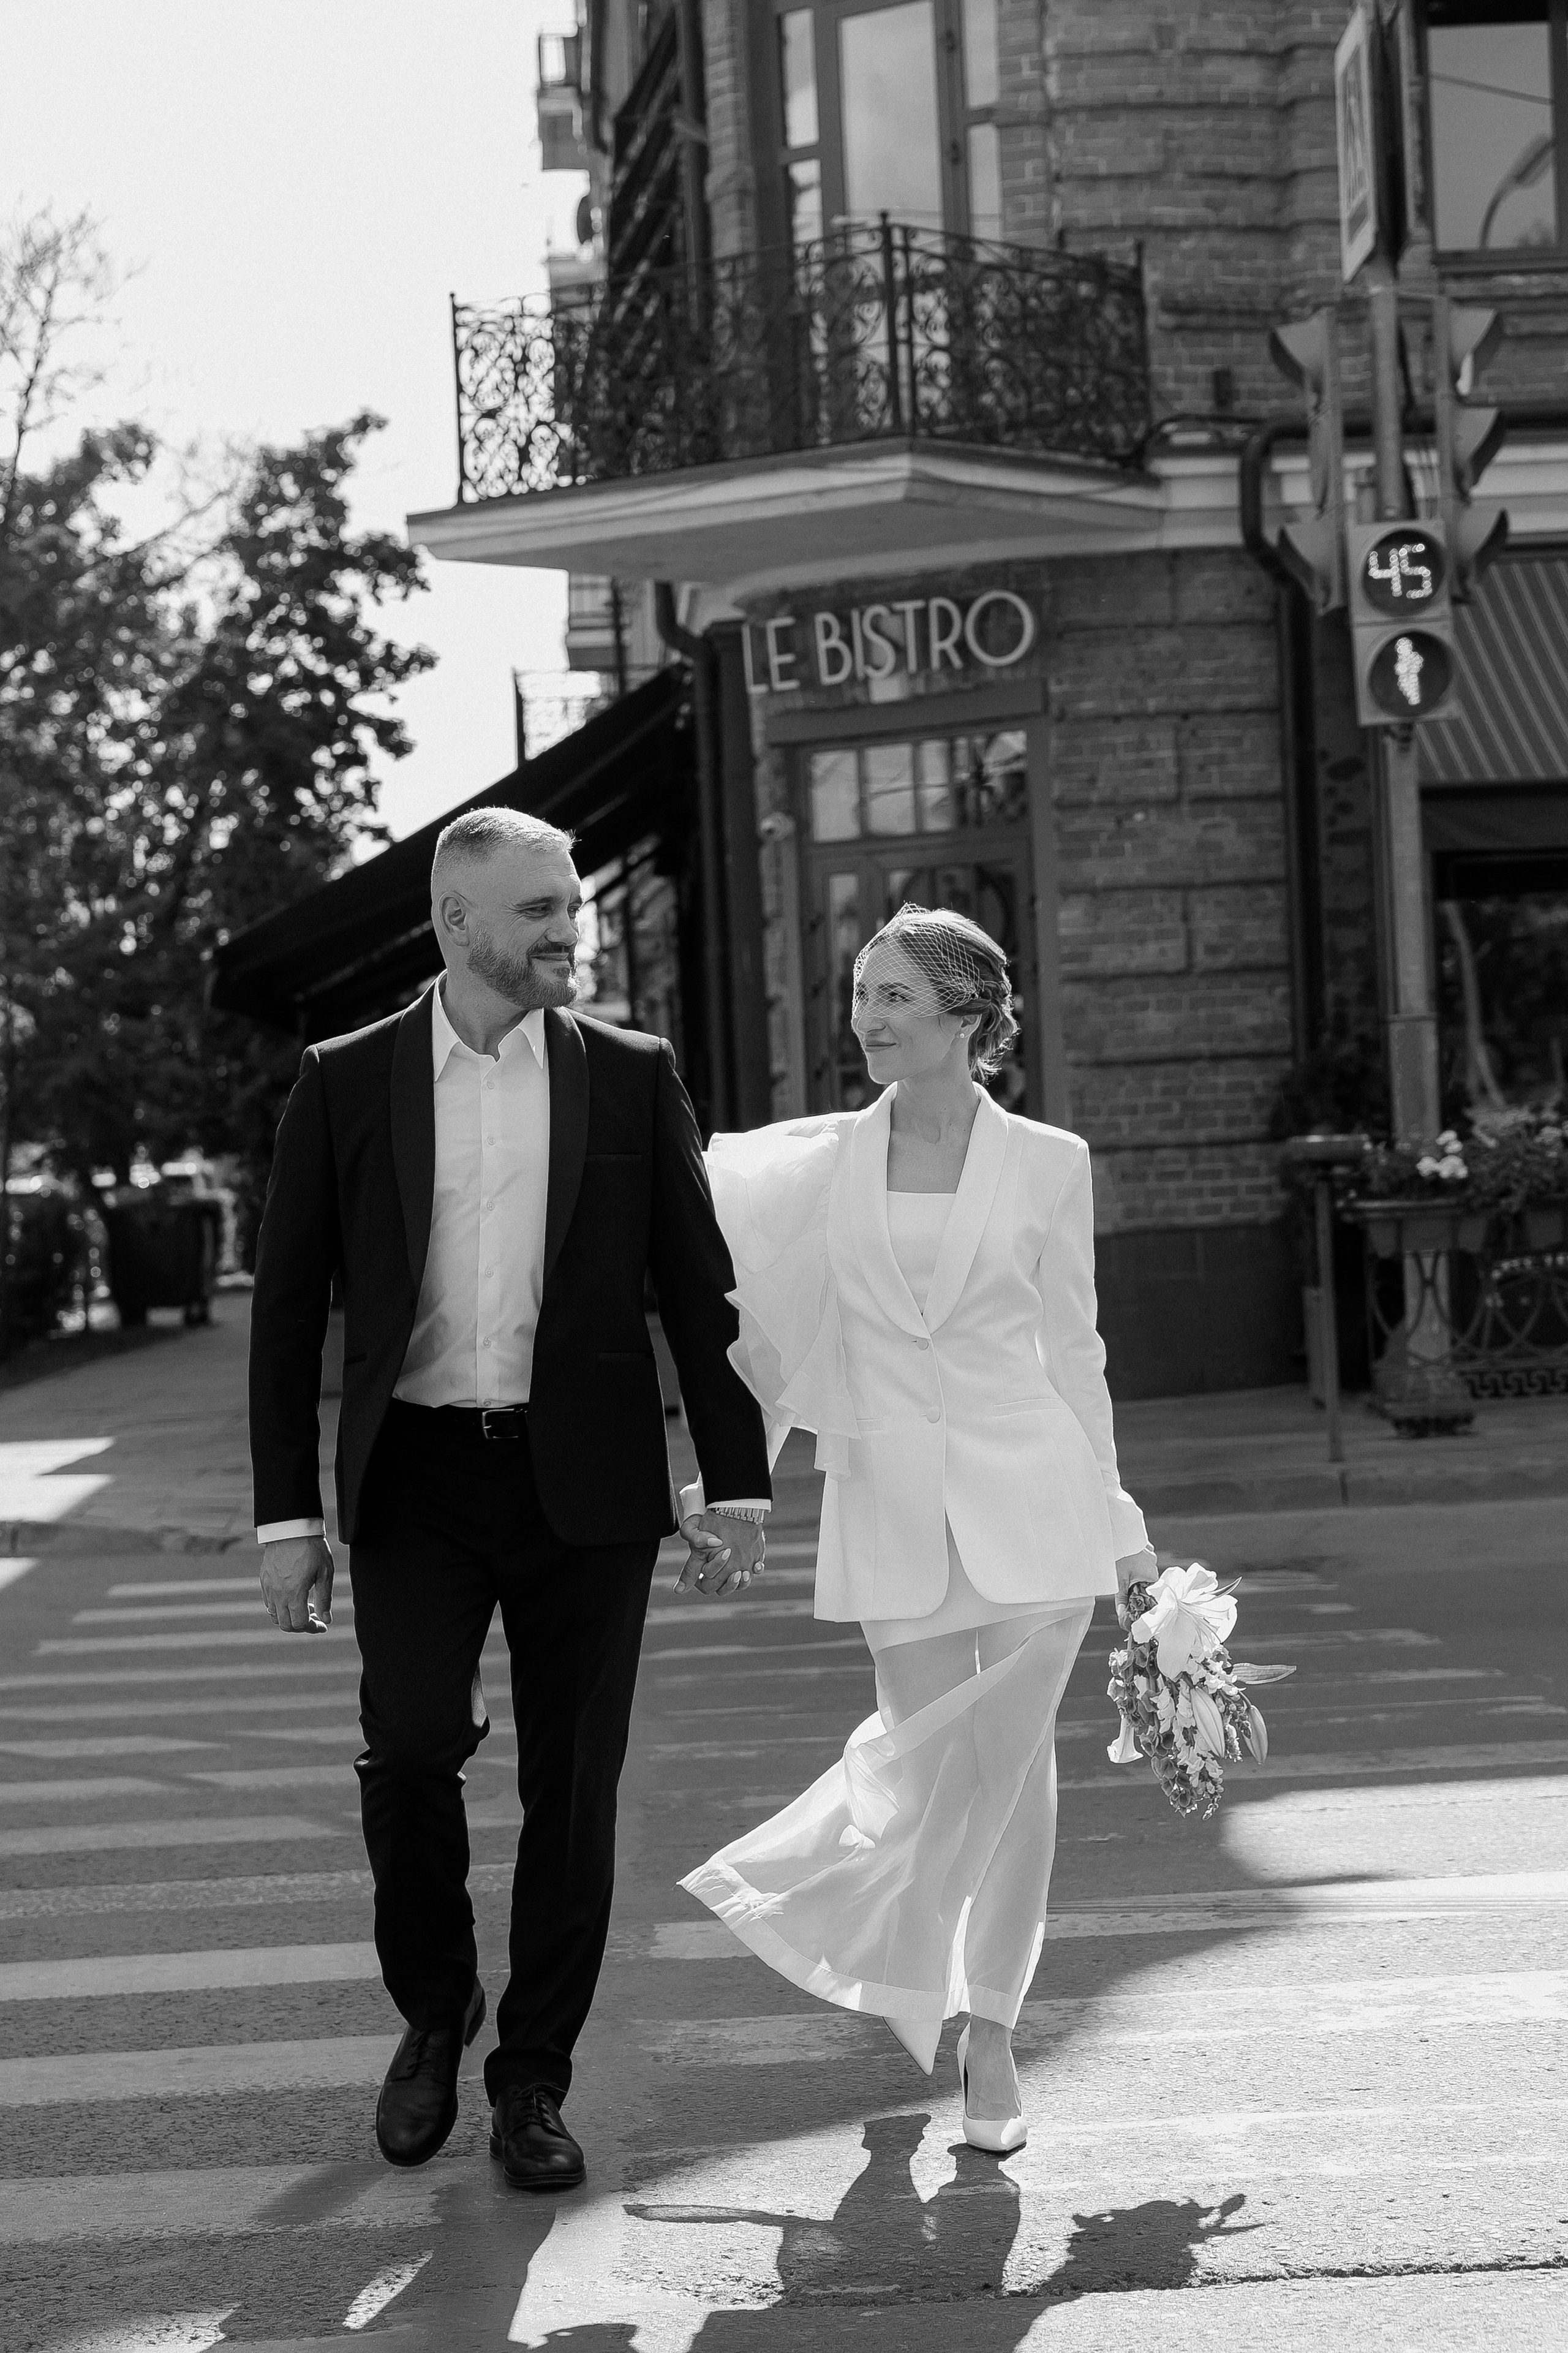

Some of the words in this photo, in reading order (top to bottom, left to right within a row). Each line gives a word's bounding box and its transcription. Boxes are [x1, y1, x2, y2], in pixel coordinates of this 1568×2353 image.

[1368, 543, 1433, 599] 45
[742, 618, 799, 695] LE
[815, 589, 1034, 685] BISTRO
